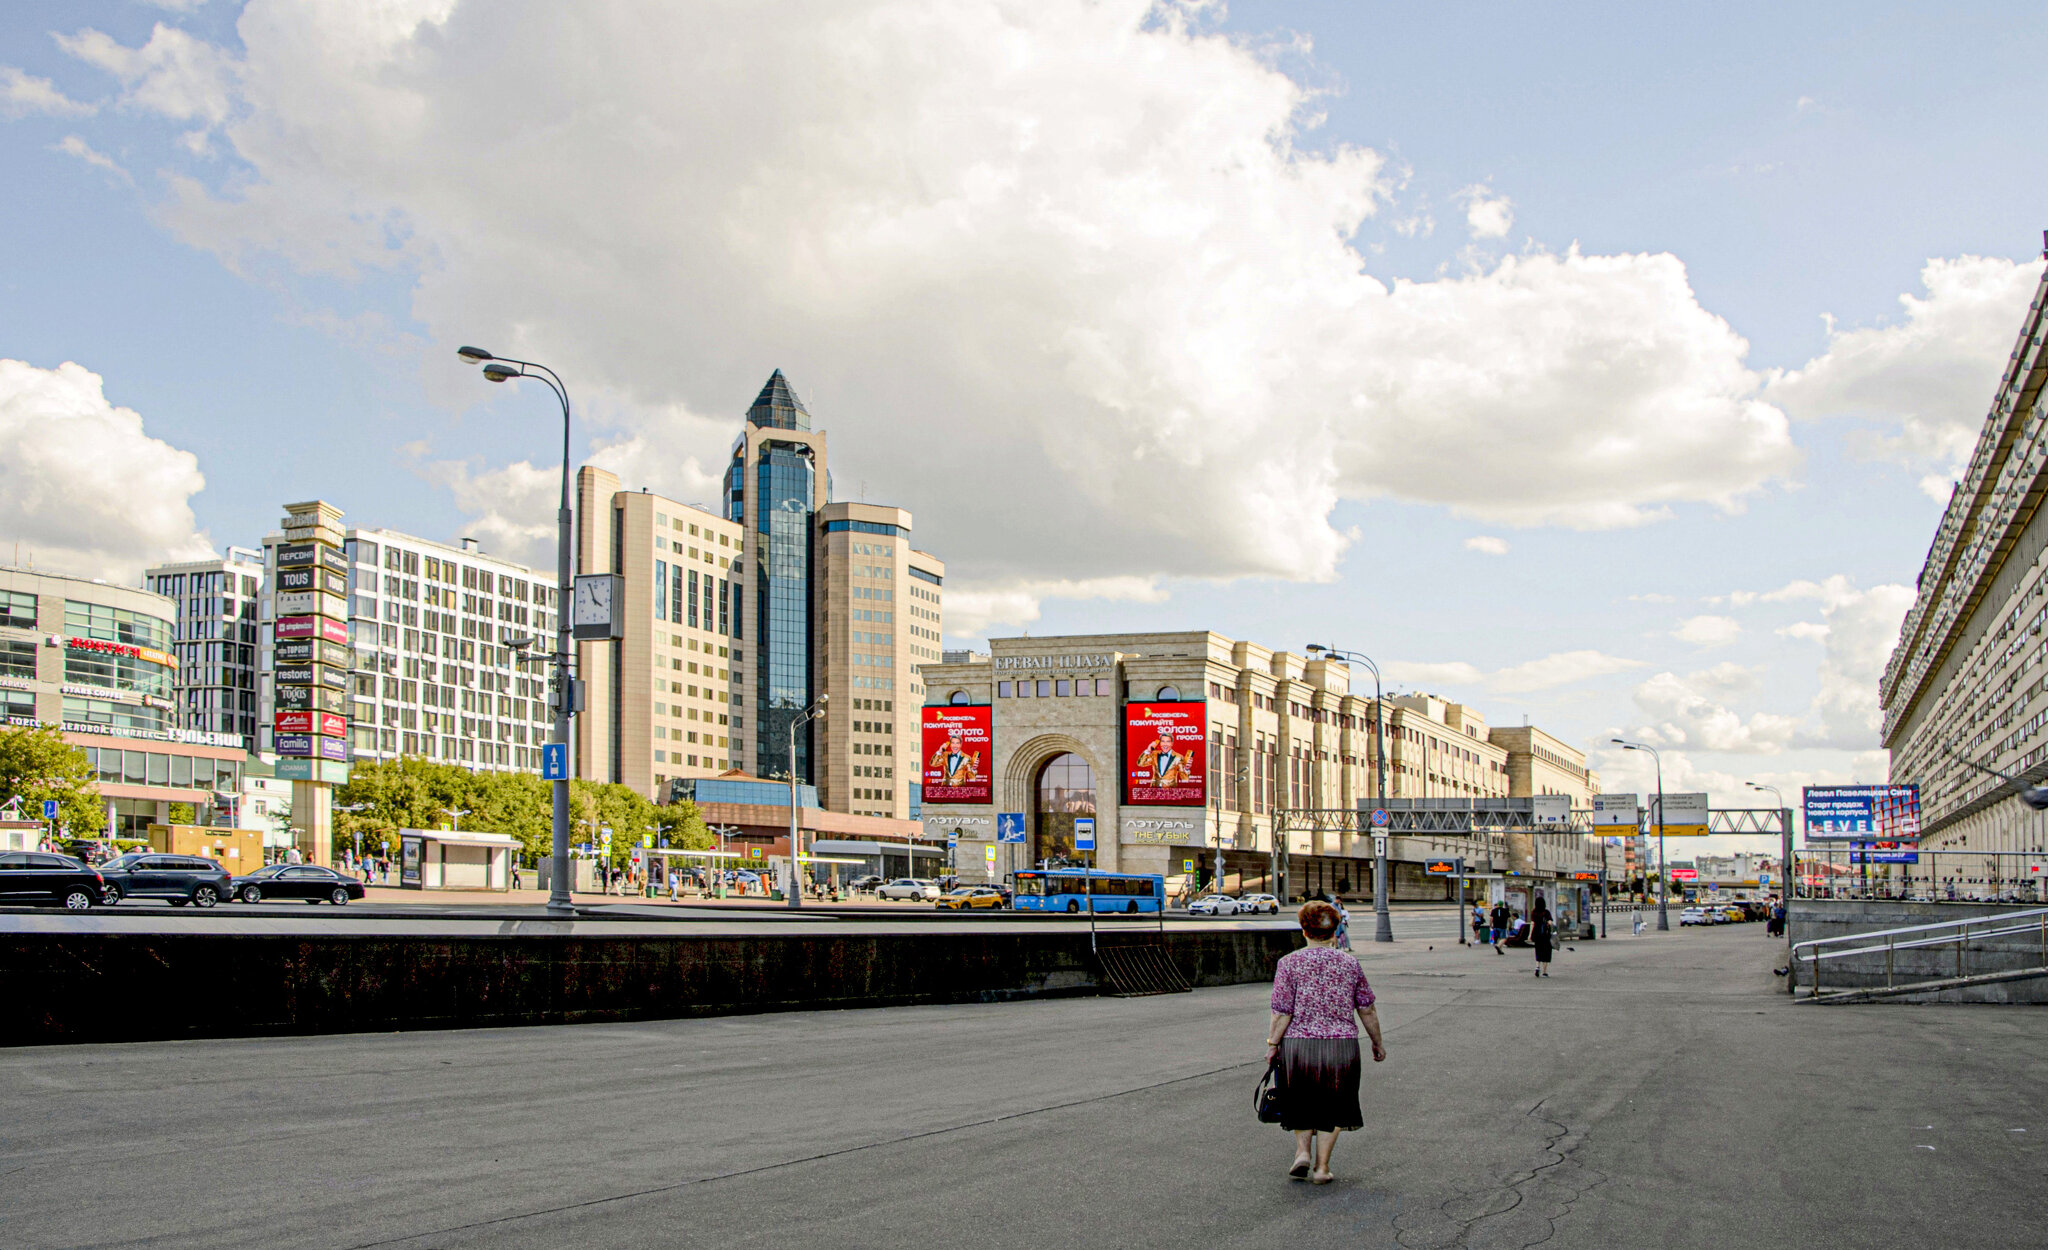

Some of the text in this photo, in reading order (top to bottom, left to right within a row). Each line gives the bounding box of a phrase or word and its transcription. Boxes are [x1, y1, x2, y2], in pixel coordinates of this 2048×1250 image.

[284, 573, 309, 586] TOUS
[328, 575, 345, 592] TOUS
[281, 594, 311, 602] FALKE
[995, 655, 1111, 669] ЕРЕВАН ПЛАЗА
[278, 670, 312, 679] restore:
[62, 685, 123, 699] STARS COFFEE
[948, 728, 984, 736] ЗОЛОТО
[1157, 726, 1198, 734] ЗОЛОТО
[1890, 788, 1913, 796] Сити
[1836, 809, 1869, 817] корпуса
[1808, 820, 1882, 832] LEVEL
[1134, 831, 1190, 840] THE БЫК
